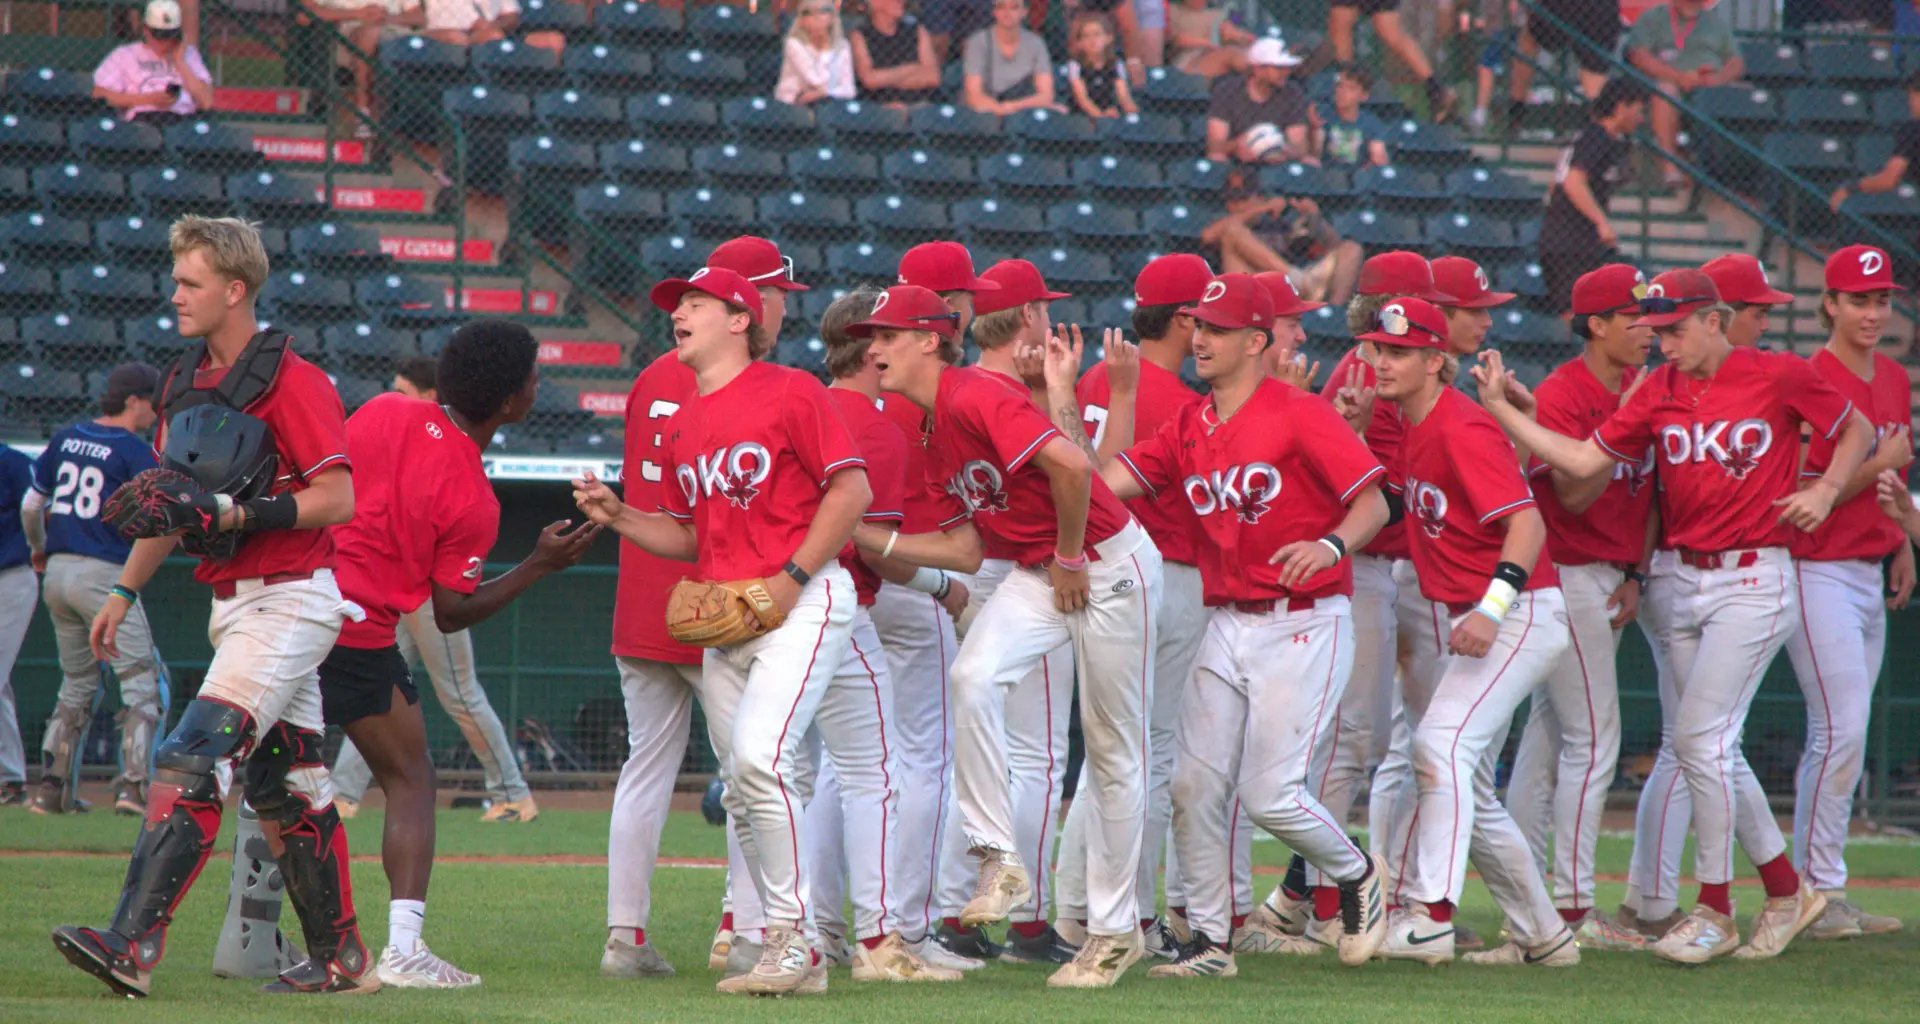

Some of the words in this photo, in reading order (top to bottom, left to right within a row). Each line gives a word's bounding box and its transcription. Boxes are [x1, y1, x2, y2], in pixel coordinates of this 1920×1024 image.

[1859, 251, 1883, 275] D
[61, 438, 112, 462] POTTER
[51, 461, 104, 519] 28
